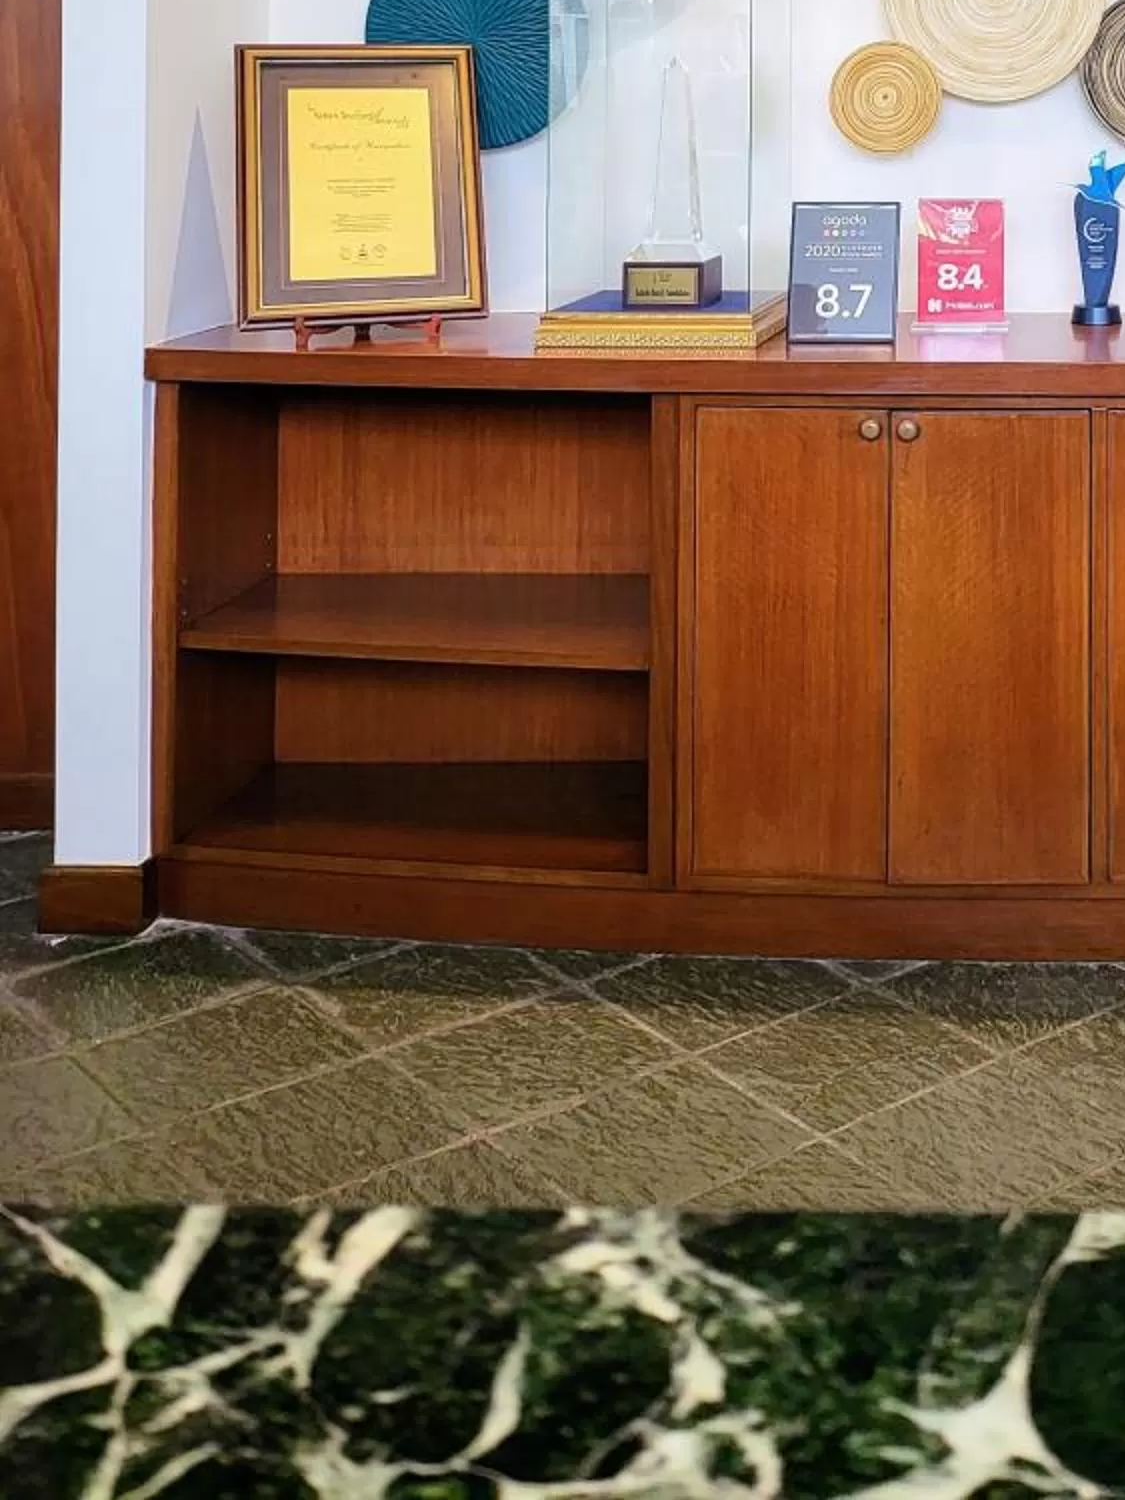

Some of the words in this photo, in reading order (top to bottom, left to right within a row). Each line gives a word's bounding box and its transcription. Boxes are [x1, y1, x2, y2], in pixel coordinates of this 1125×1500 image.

[823, 213, 867, 229] agoda
[804, 243, 841, 258] 2020
[937, 262, 984, 291] 8.4
[815, 283, 873, 319] 8.7
